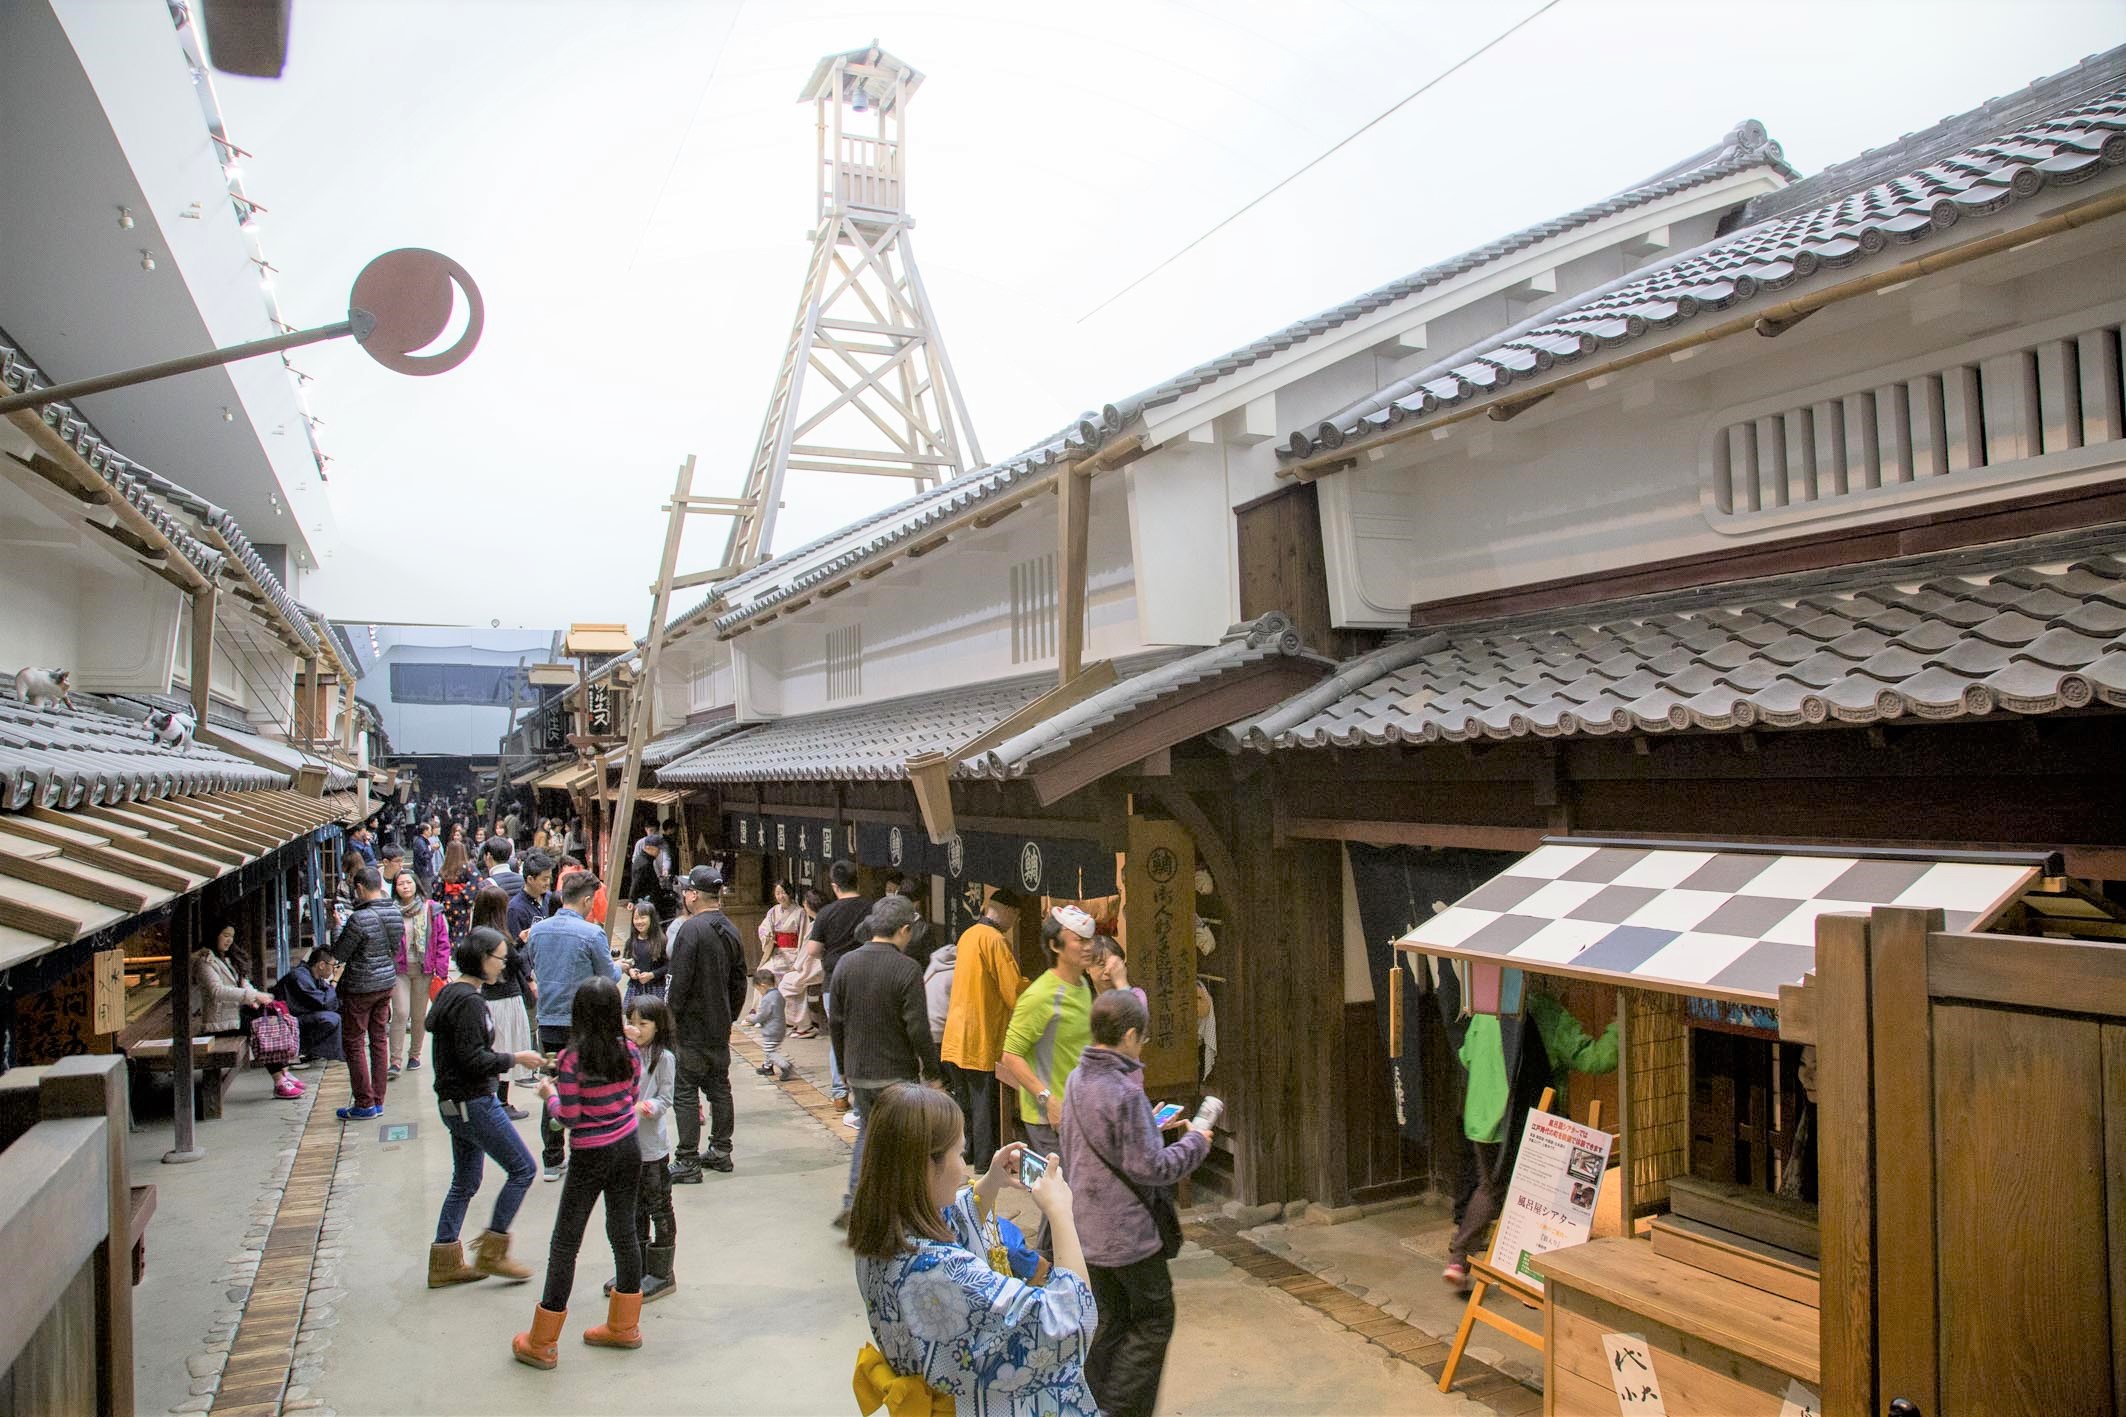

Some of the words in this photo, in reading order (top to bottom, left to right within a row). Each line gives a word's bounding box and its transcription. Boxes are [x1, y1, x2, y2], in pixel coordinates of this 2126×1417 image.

[1517, 1195, 1577, 1227] 風呂屋シアター
[1614, 1347, 1647, 1373] 代
